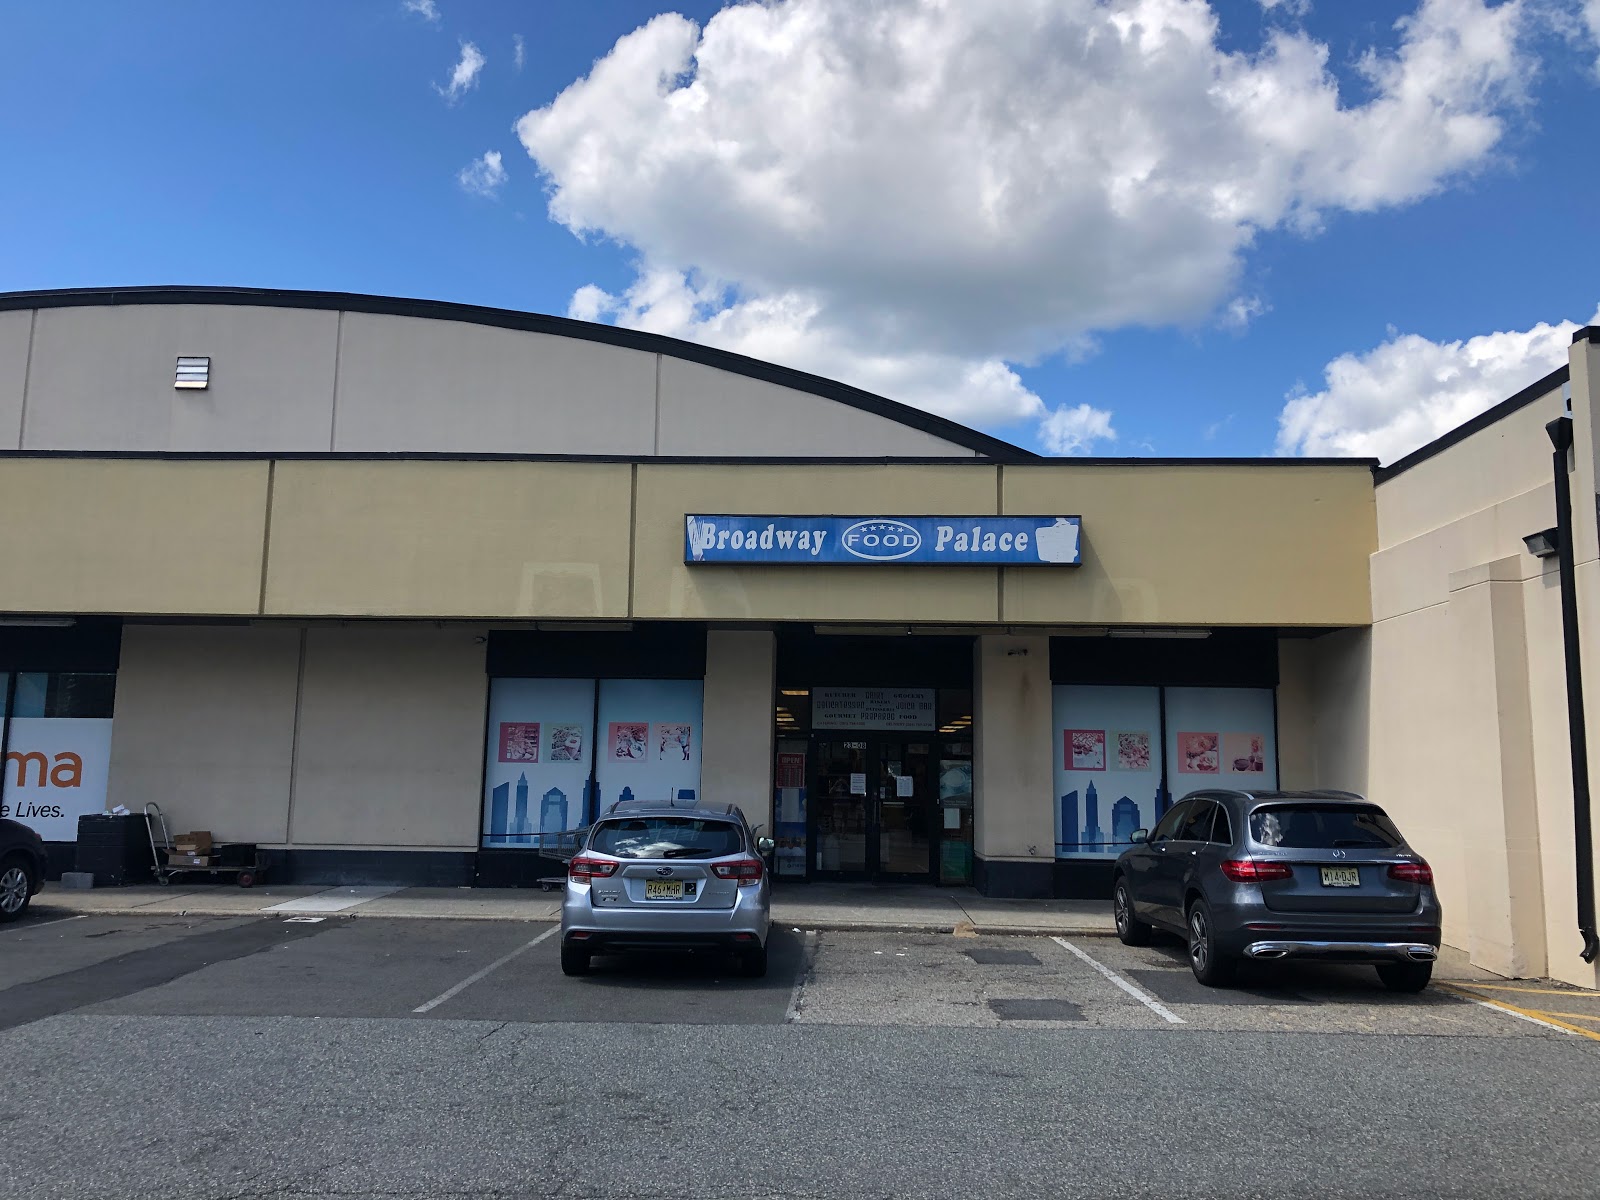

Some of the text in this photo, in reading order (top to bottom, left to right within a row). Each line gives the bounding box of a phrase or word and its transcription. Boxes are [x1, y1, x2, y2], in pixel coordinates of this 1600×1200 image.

[701, 523, 1029, 556] Broadway FOOD Palace
[15, 801, 65, 818] Lives.
